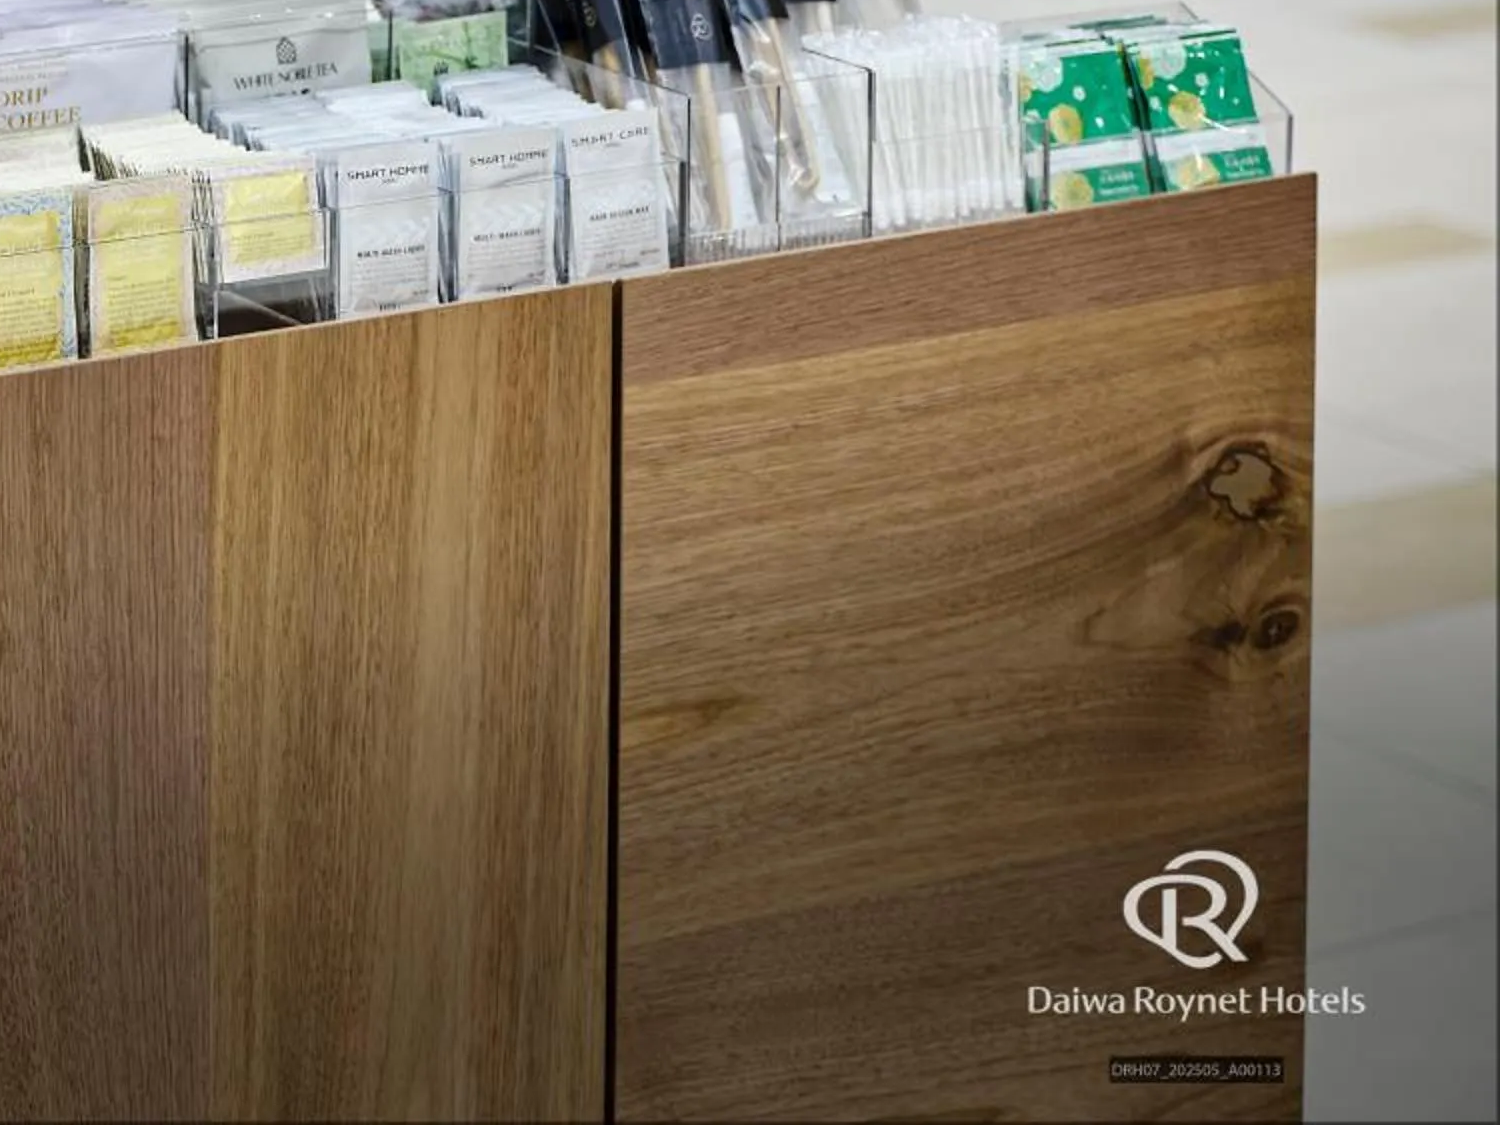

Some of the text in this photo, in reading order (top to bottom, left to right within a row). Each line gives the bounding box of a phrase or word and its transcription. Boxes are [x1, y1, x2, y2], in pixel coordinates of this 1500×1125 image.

[233, 75, 273, 91] WHITE
[317, 62, 338, 76] TEA
[470, 154, 505, 167] SMART
[347, 168, 386, 180] SMART
